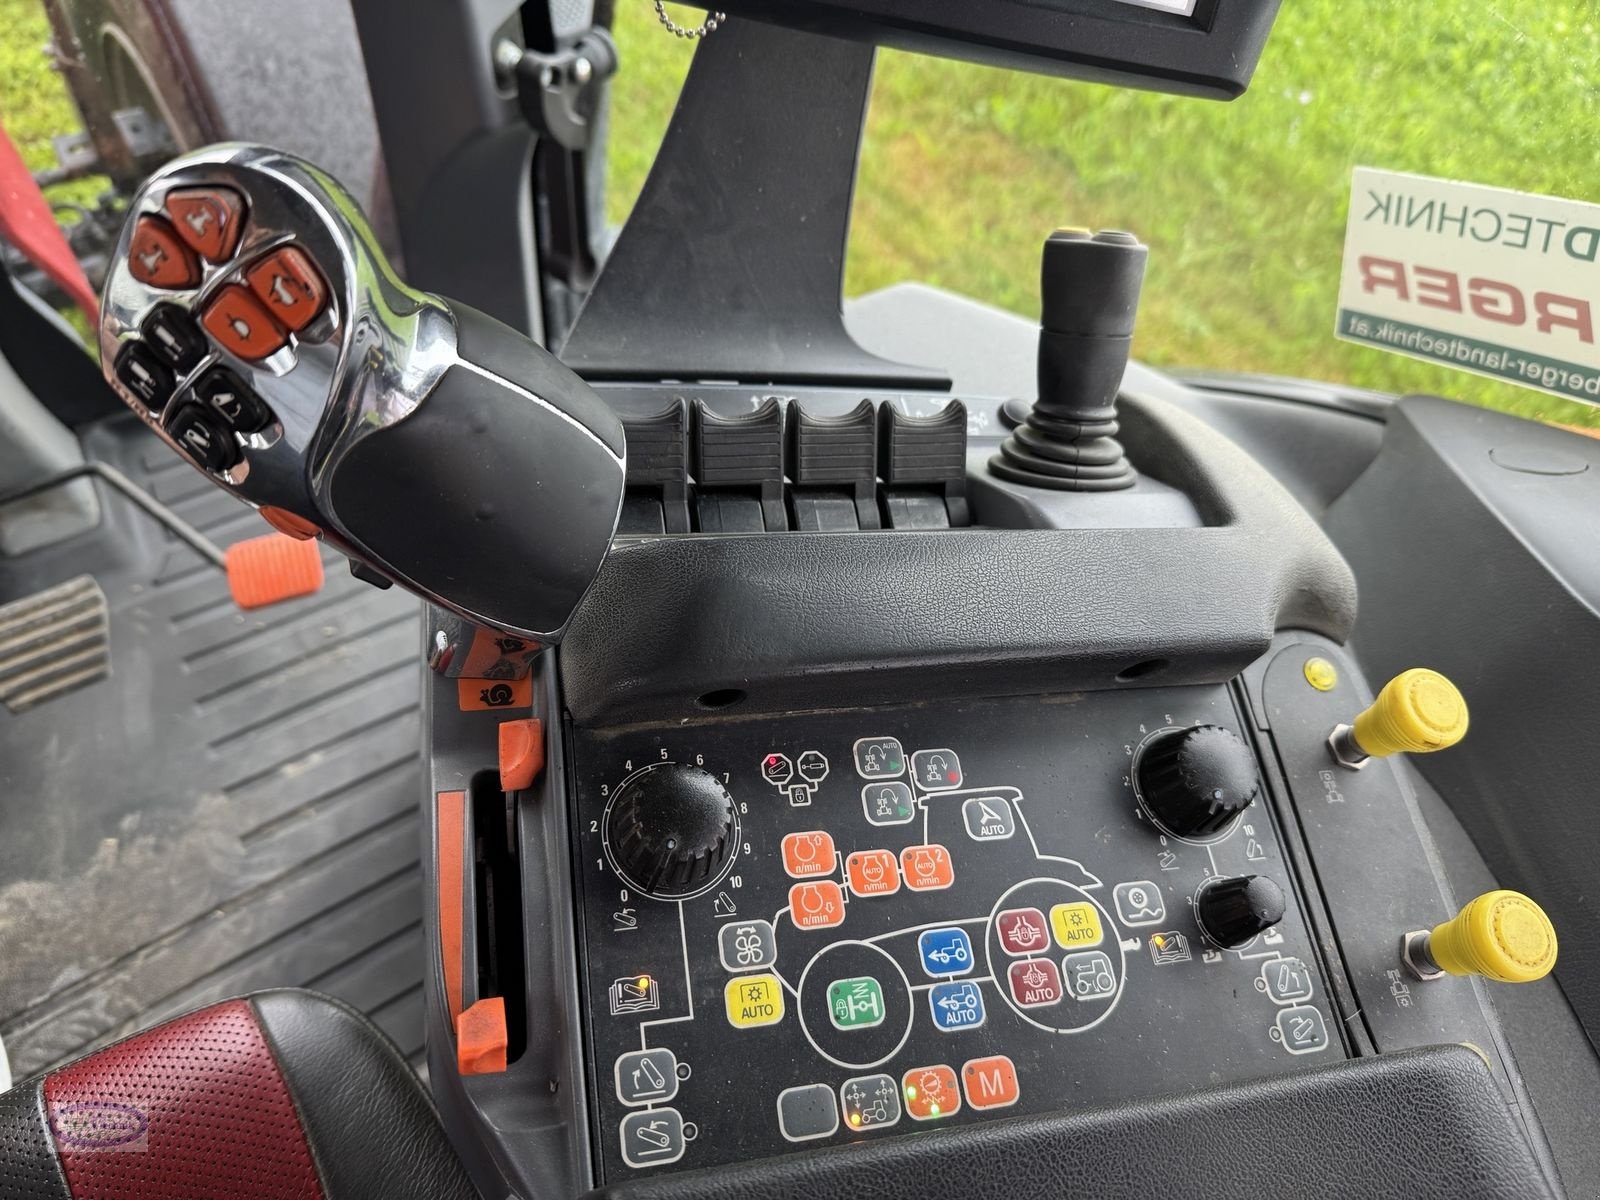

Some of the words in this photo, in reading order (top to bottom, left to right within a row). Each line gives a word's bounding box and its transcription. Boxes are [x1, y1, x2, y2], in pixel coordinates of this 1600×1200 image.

[1165, 714, 1172, 724] 5
[1139, 724, 1146, 734] 4
[882, 741, 898, 749] AUTO
[1124, 745, 1132, 755] 3
[660, 749, 669, 760] 5
[625, 760, 633, 771] 4
[696, 755, 704, 766] 6
[723, 773, 730, 784] 7
[601, 785, 609, 796] 3
[740, 803, 748, 814] 8
[1135, 808, 1142, 819] 1
[590, 821, 598, 832] 2
[980, 824, 1005, 836] AUTO
[1243, 824, 1255, 836] 10
[1159, 835, 1167, 846] 0
[743, 843, 751, 854] 9
[882, 854, 889, 867] 1
[935, 849, 943, 862] 2
[597, 859, 602, 870] 1
[795, 862, 821, 873] n/min
[1203, 868, 1210, 876] 5
[730, 876, 743, 888] 10
[863, 881, 888, 891] n/min
[916, 876, 940, 886] n/min
[620, 890, 628, 902] 0
[1186, 896, 1192, 904] 3
[802, 913, 829, 925] n/min
[1067, 927, 1094, 941] AUTO
[1025, 988, 1054, 1003] AUTO
[741, 1003, 774, 1019] AUTO
[946, 1010, 976, 1025] AUTO
[978, 1068, 1004, 1098] M
